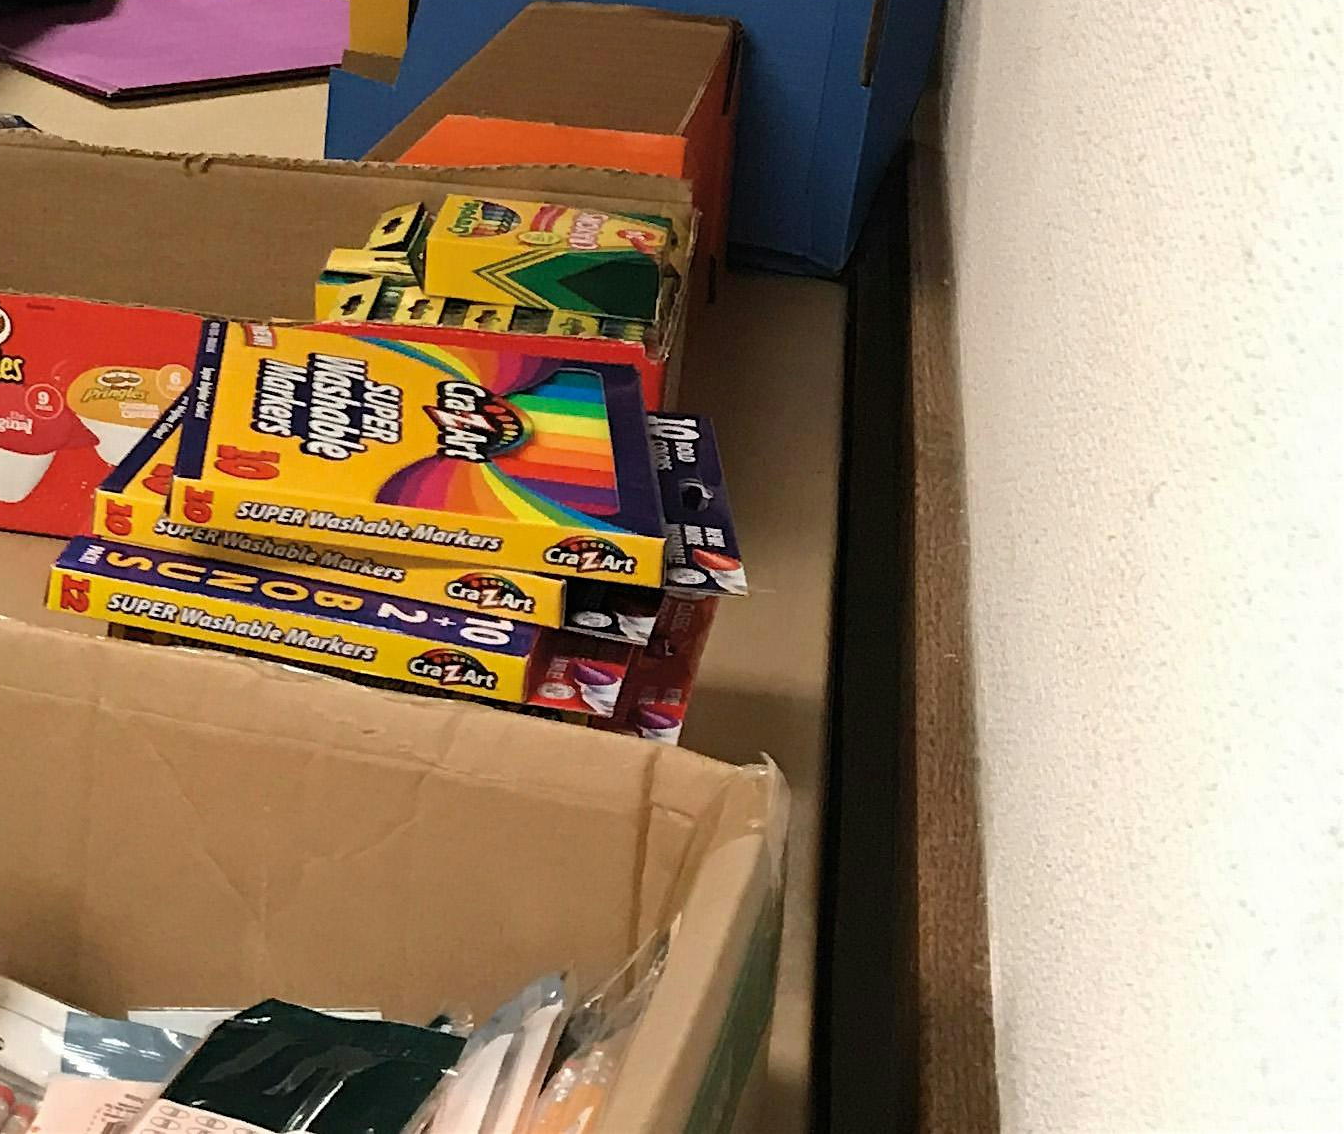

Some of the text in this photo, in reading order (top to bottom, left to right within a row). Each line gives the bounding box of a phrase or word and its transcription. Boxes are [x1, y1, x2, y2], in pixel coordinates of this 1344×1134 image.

[37, 391, 49, 404] 9
[81, 386, 148, 403] Pringles
[258, 359, 307, 436] Markers
[306, 354, 367, 460] Washable
[363, 379, 401, 444] SUPER
[214, 444, 280, 480] 10
[106, 499, 133, 536] 10
[154, 517, 220, 546] SUPER
[223, 531, 316, 565] Washable
[319, 552, 405, 582] Markers
[184, 486, 215, 523] 10
[237, 502, 307, 525] SUPER
[309, 511, 412, 540] Washable
[412, 525, 503, 551] Markers
[60, 574, 90, 613] 12
[107, 593, 179, 623] SUPER
[180, 606, 282, 643] Washable
[284, 628, 377, 660] Markers
[376, 602, 429, 624] 2
[460, 617, 514, 645] 10
